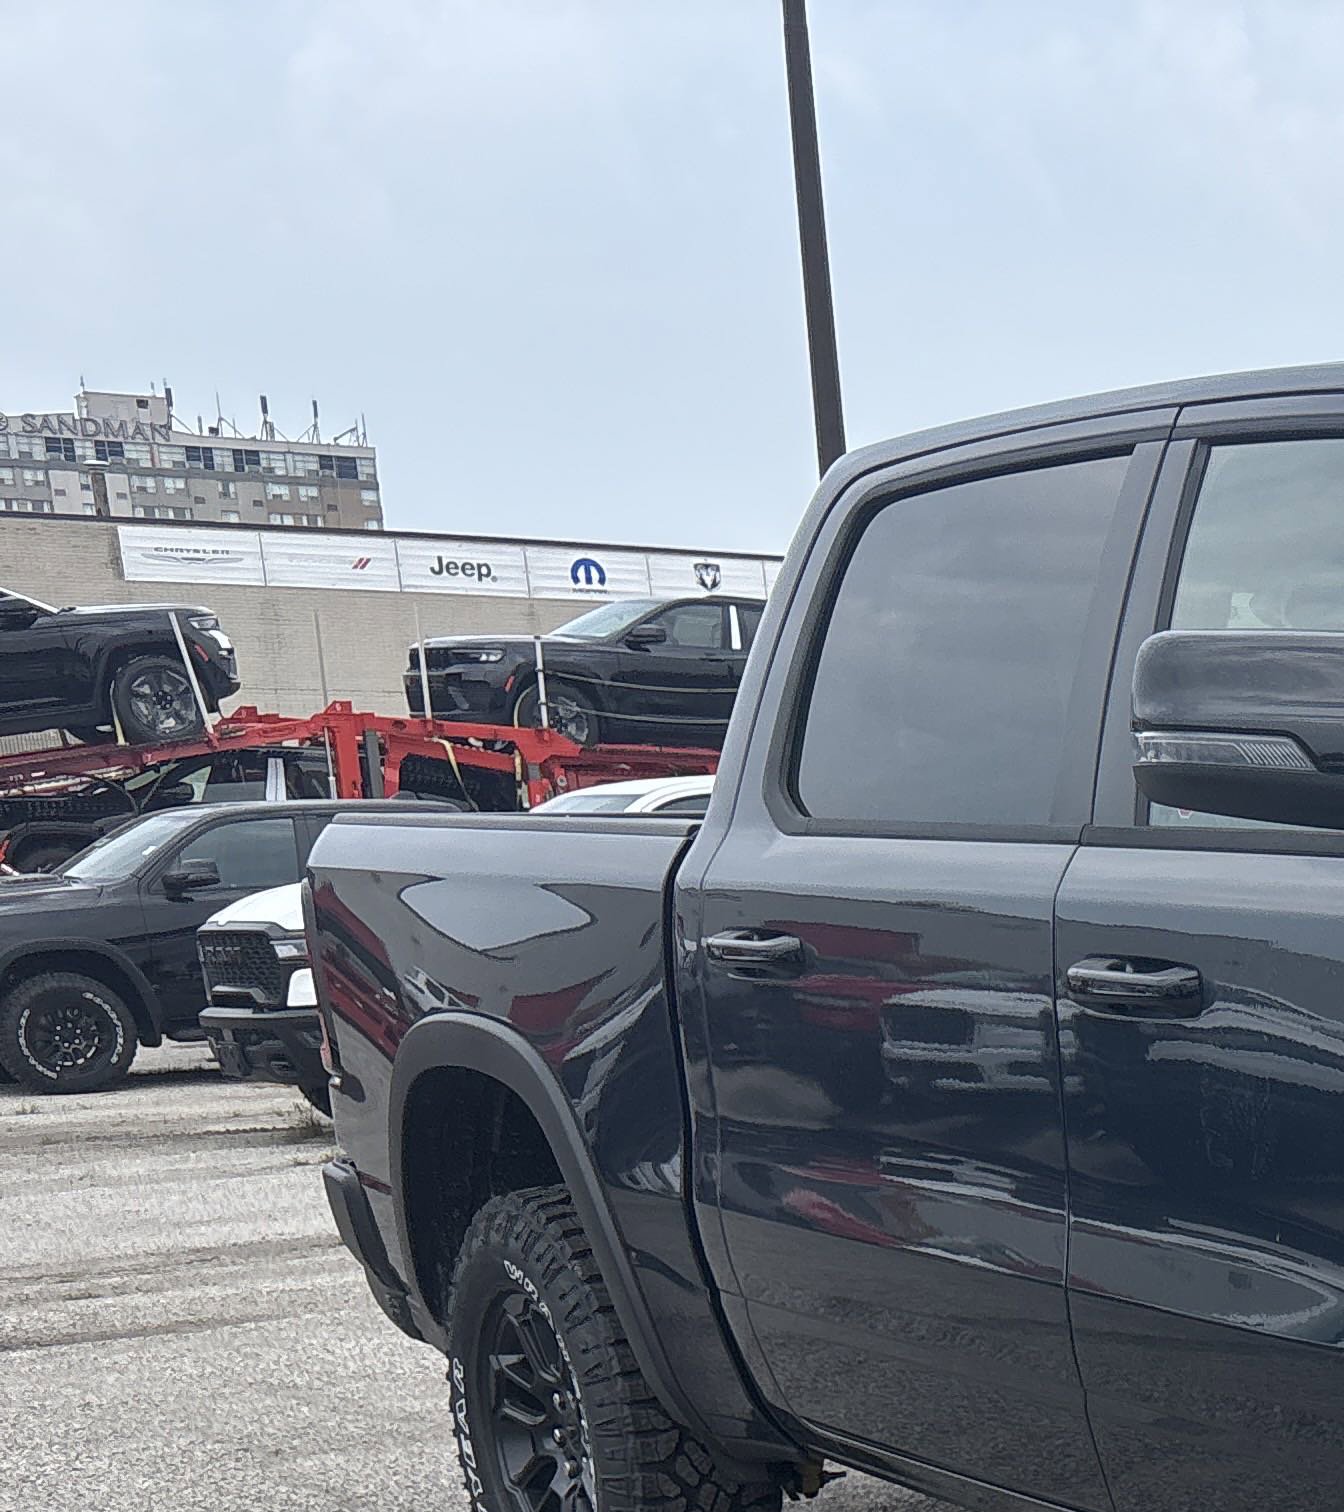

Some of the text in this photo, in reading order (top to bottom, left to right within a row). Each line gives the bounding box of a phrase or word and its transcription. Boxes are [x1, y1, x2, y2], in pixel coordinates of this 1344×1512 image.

[20, 413, 171, 442] SANDMAN
[153, 546, 230, 555] CHRYSLER
[430, 556, 492, 582] Jeep
